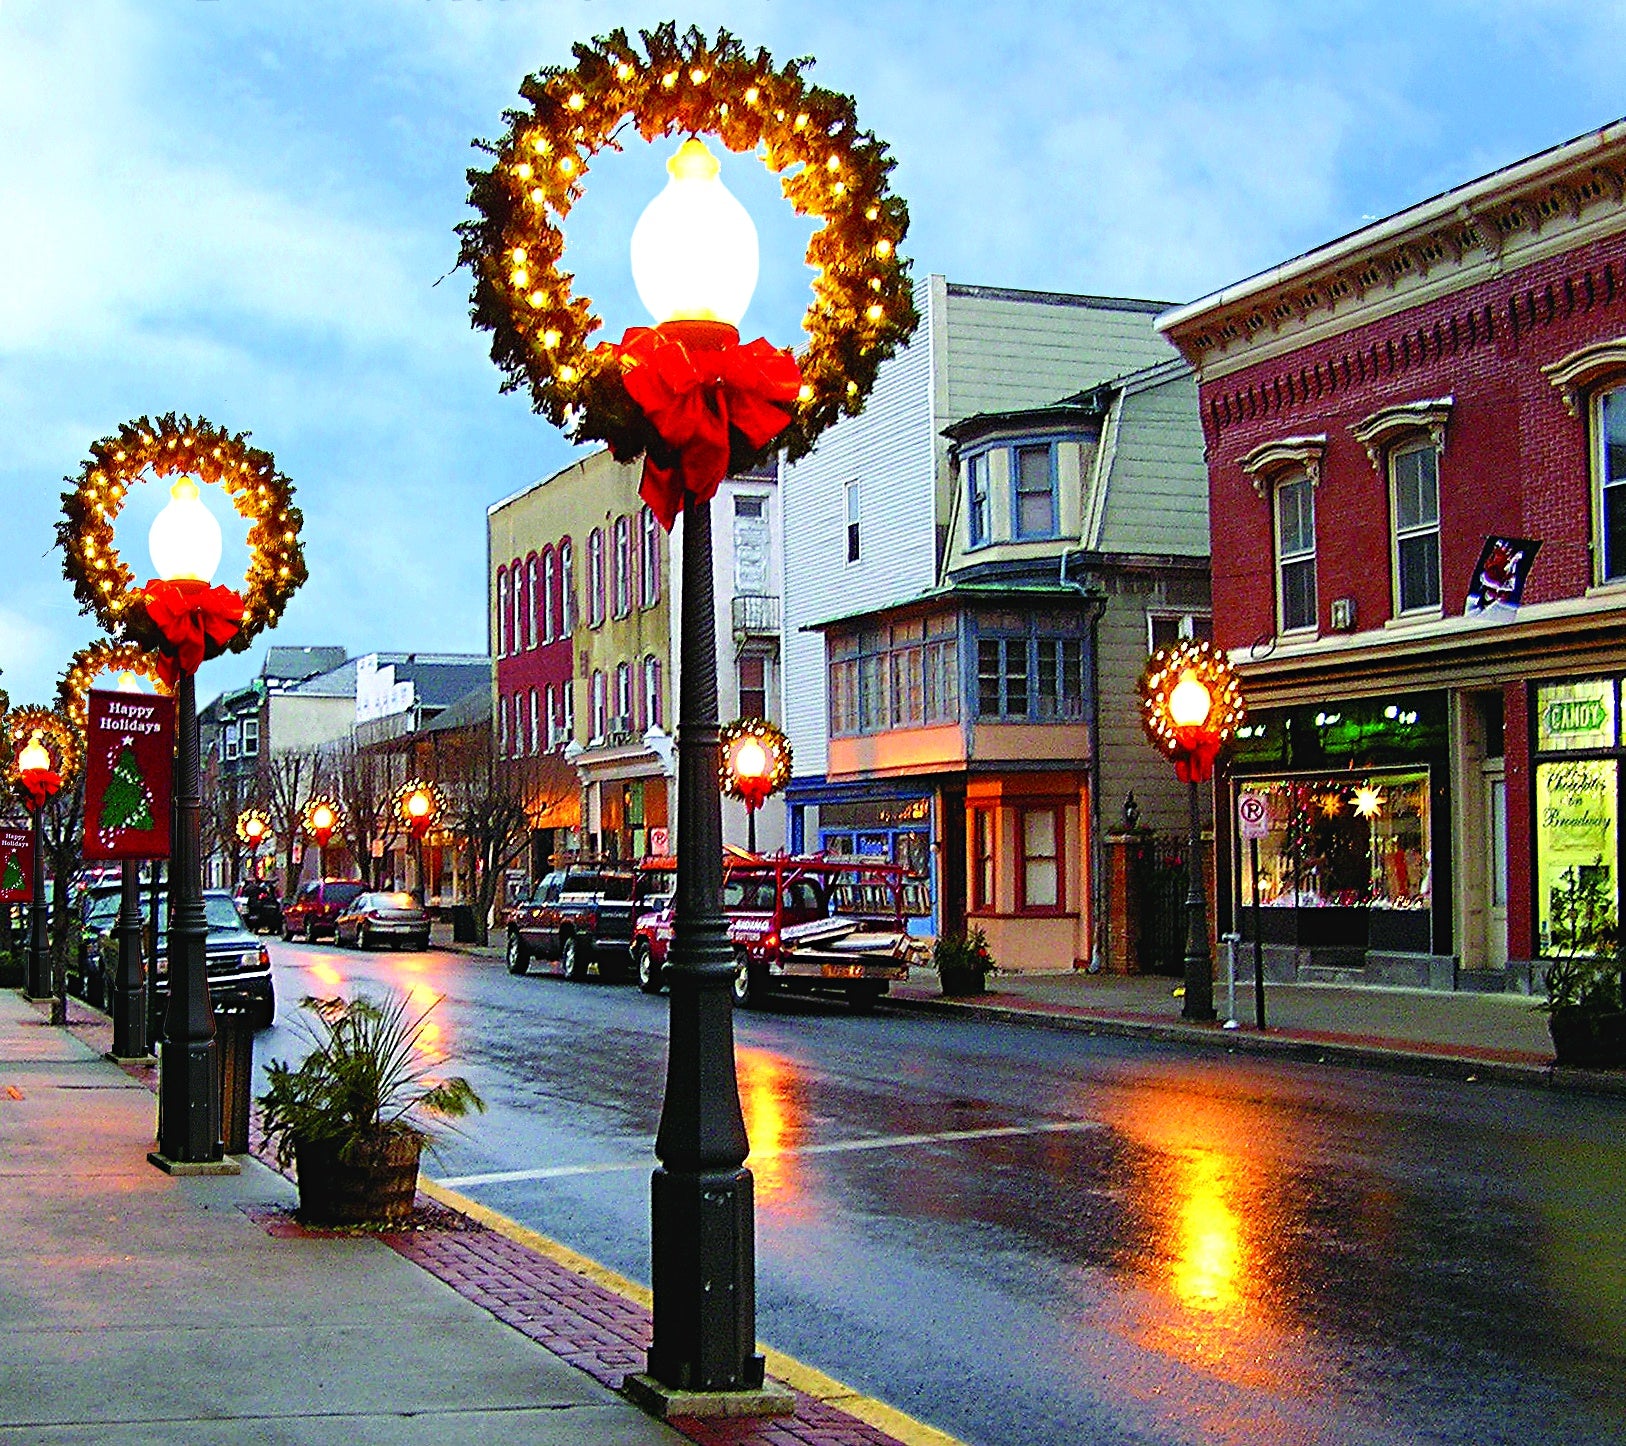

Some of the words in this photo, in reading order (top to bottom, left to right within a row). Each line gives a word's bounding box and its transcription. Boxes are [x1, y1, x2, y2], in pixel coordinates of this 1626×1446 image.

[109, 702, 154, 719] Happy
[1551, 703, 1600, 729] CANDY
[100, 717, 161, 735] Holidays
[1, 840, 29, 848] Holidays
[5, 833, 26, 841] Happy
